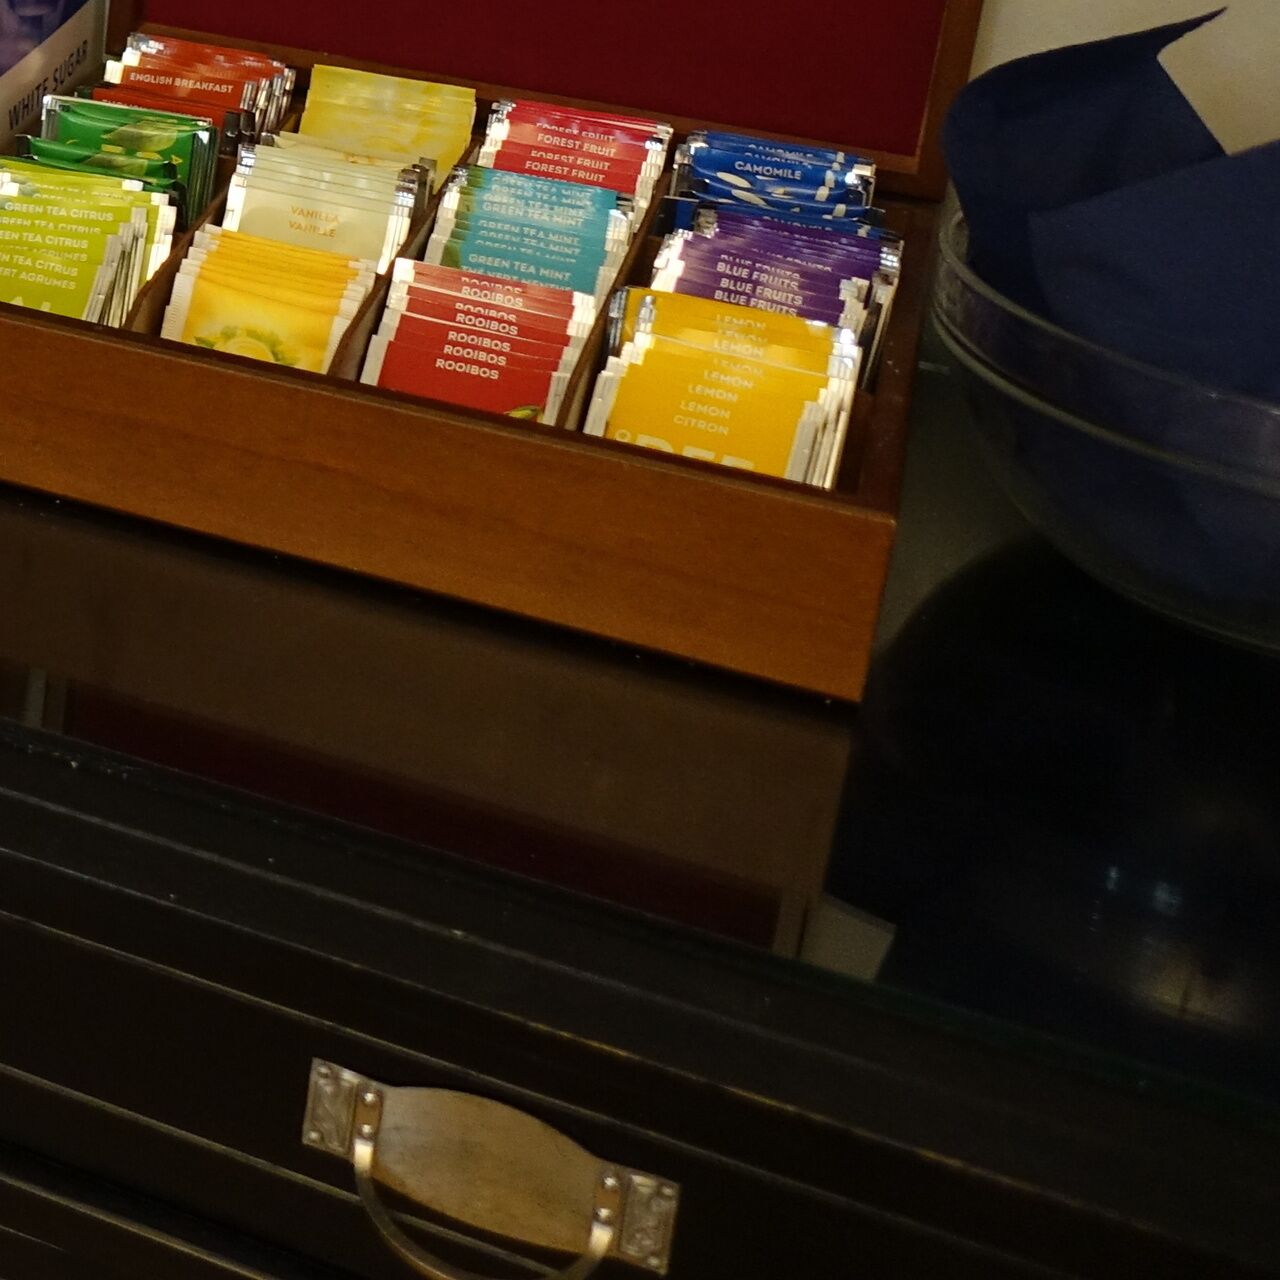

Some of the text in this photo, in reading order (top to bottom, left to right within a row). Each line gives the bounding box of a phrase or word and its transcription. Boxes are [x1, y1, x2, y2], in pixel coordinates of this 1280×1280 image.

[8, 39, 89, 130] WHITE SUGAR
[129, 72, 234, 93] ENGLISH BREAKFAST
[537, 133, 617, 157] FOREST FRUIT
[525, 160, 570, 175] FOREST
[571, 168, 606, 183] FRUIT
[576, 157, 611, 170] FRUIT
[734, 161, 803, 180] CAMOMILE
[4, 201, 114, 222] GREEN TEA CITRUS
[290, 205, 341, 224] VANILLA
[482, 201, 524, 217] GREEN
[527, 209, 550, 222] TEA
[22, 232, 43, 245] TEA
[45, 234, 89, 249] CITRUS
[12, 252, 33, 267] TEA
[35, 258, 79, 277] CITRUS
[468, 253, 571, 280] GREEN TEA MINT
[19, 271, 77, 290] AGRUMES
[716, 261, 750, 279] BLUE
[752, 271, 800, 291] FRUITS
[461, 285, 524, 308] ROOIBOS
[719, 277, 803, 306] BLUE FRUITS
[713, 290, 798, 317] BLUE FRUITS
[455, 312, 519, 336] ROOIBOS
[447, 331, 511, 353] ROOIBOS
[713, 338, 764, 358] LEMON
[443, 344, 507, 366] ROOIBOS
[435, 358, 500, 380] ROOIBOS
[703, 369, 754, 389] LEMON
[688, 384, 738, 402] LEMON
[679, 400, 732, 419] LEMON
[673, 415, 730, 436] CITRON
